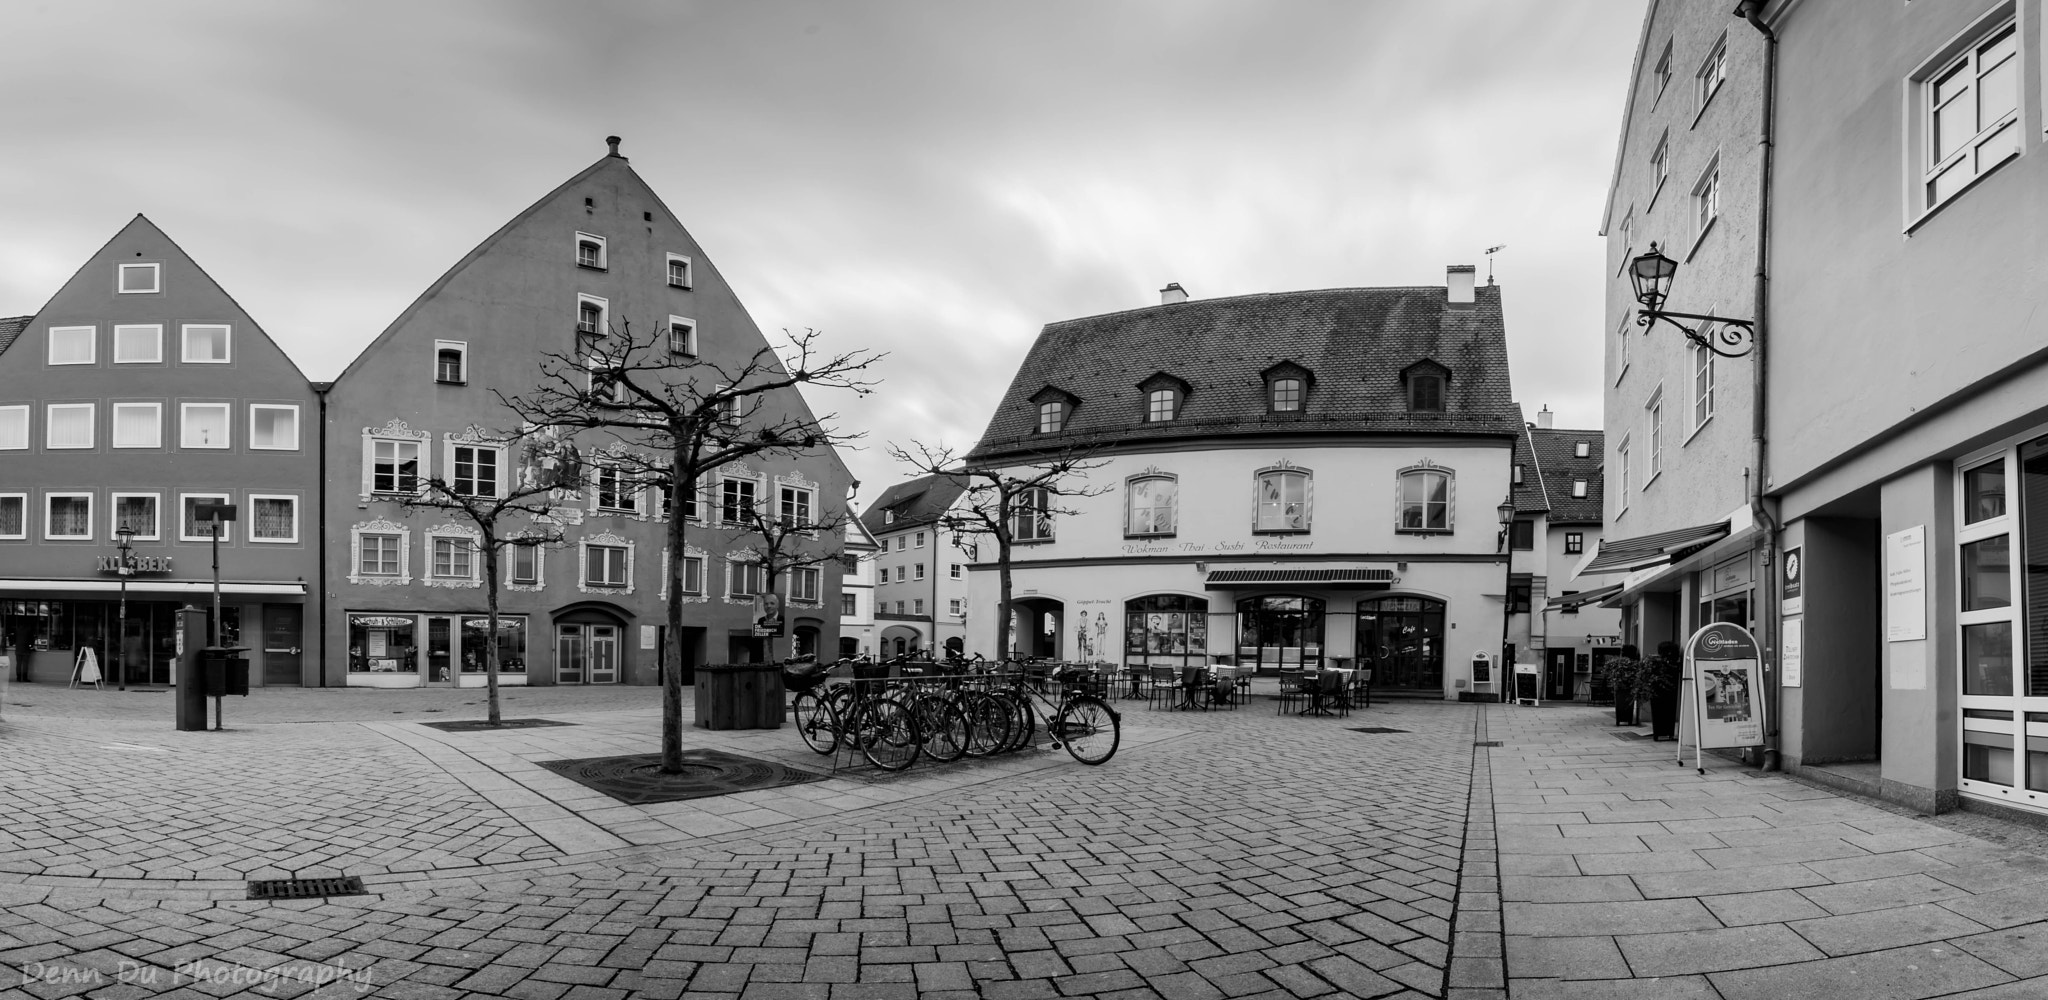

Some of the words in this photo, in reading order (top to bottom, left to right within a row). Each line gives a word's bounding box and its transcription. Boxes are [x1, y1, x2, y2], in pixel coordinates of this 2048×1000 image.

[1121, 544, 1168, 554] Wokman
[1178, 542, 1205, 553] Thai
[1214, 540, 1245, 552] Sushi
[1255, 540, 1315, 551] Restaurant
